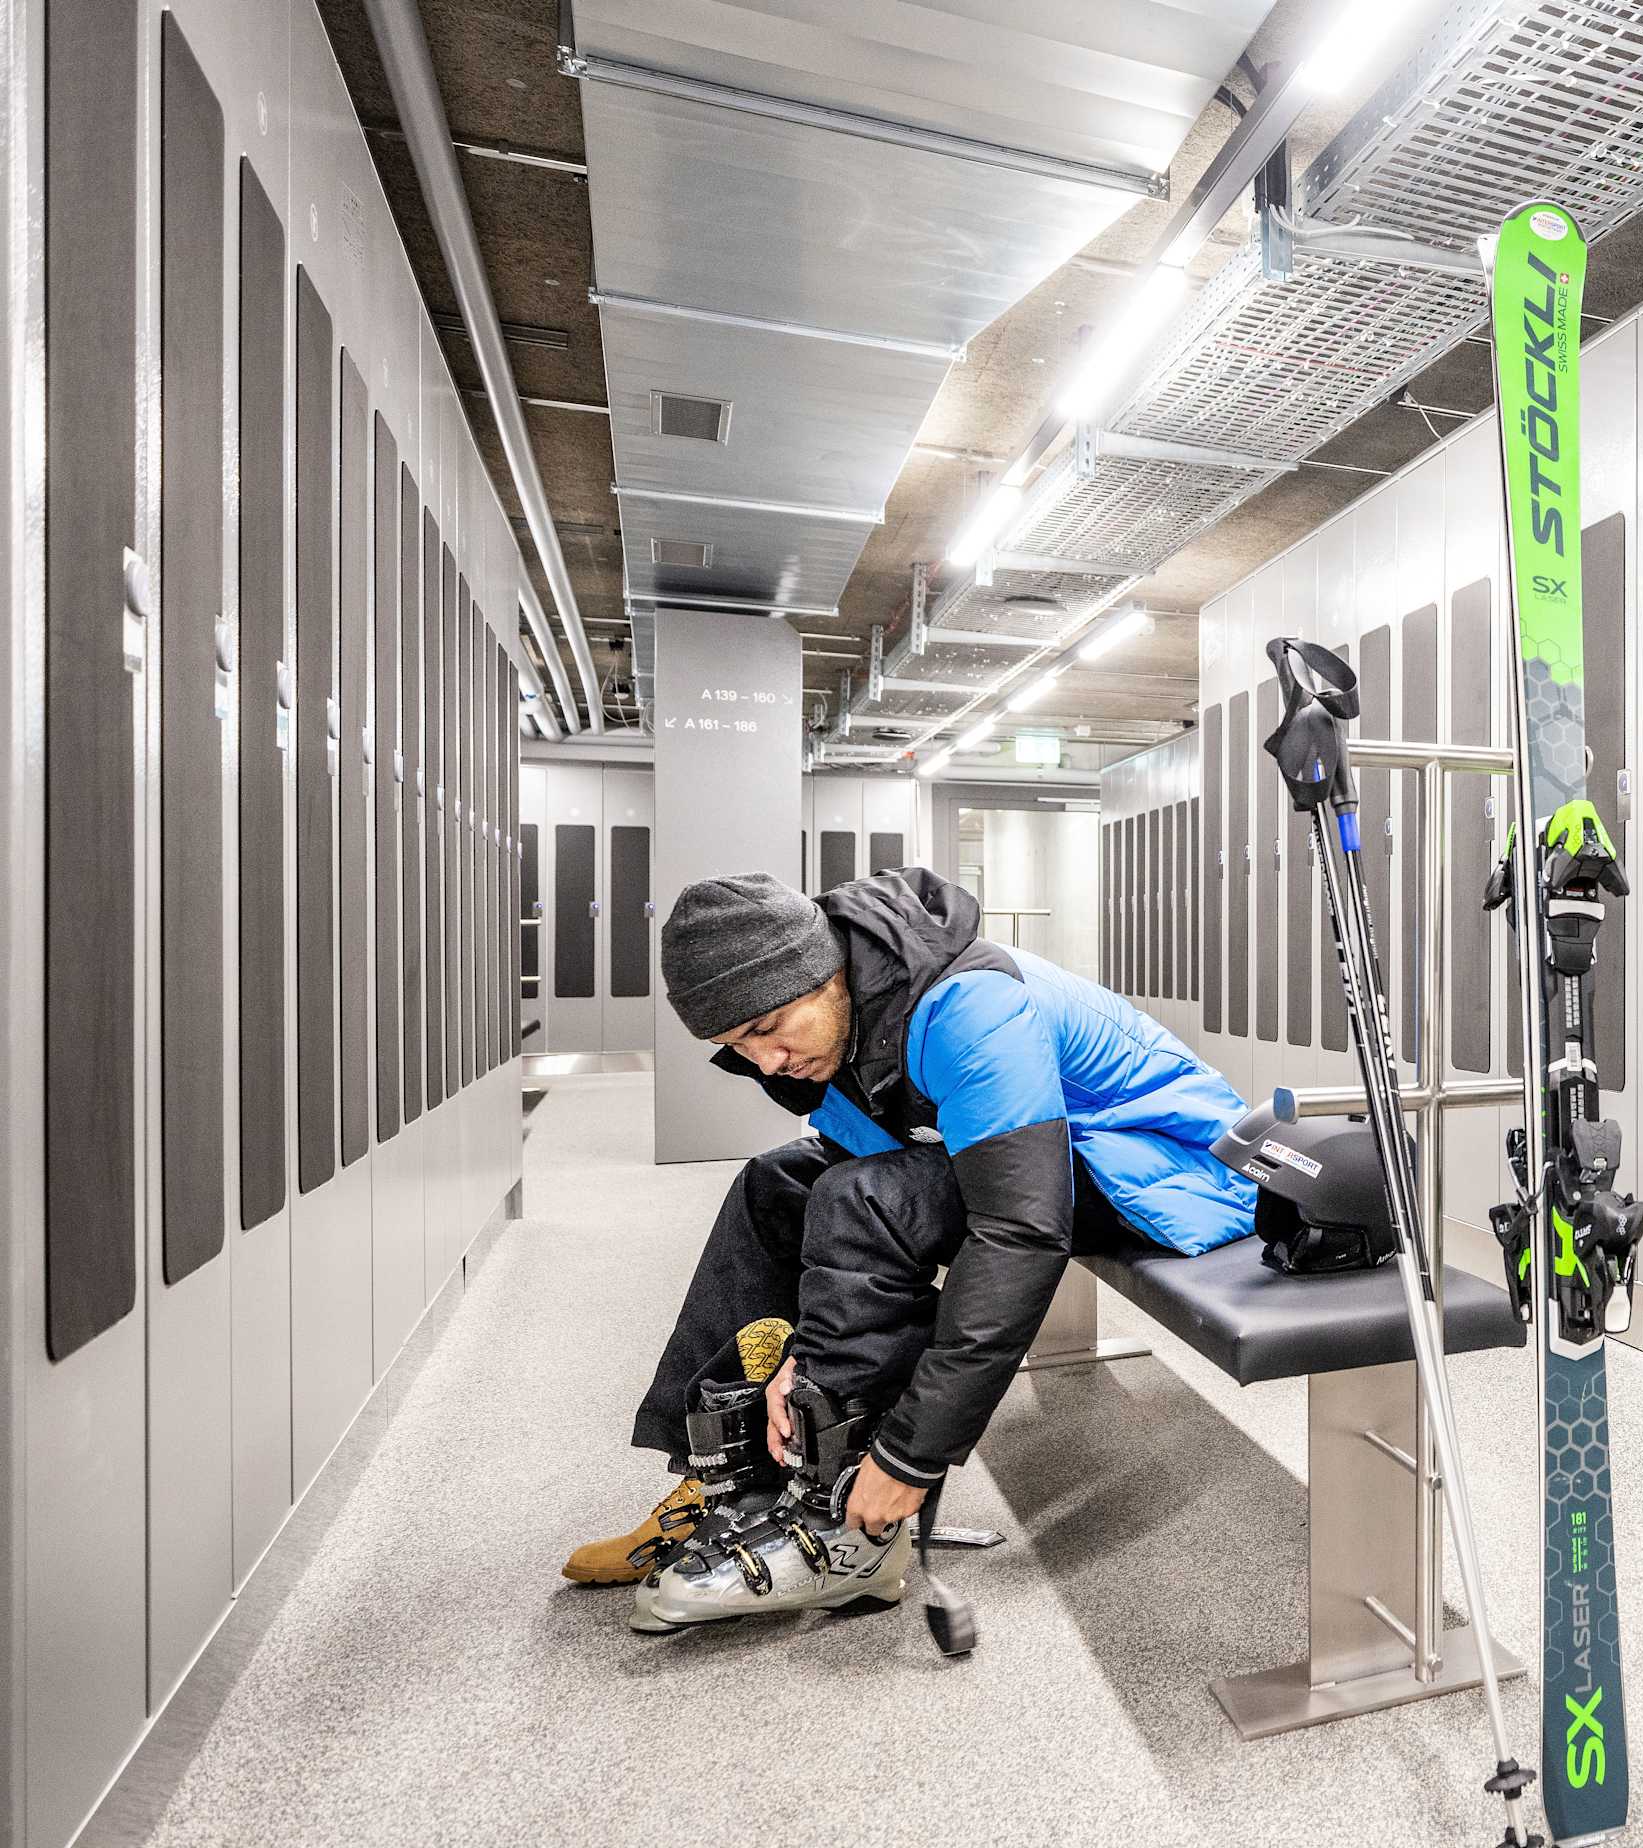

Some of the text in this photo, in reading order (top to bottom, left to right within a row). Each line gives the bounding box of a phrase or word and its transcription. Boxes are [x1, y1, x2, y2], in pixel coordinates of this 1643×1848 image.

[1557, 286, 1568, 373] SWISS MADE
[1521, 251, 1564, 557] STÖCKLI
[1532, 576, 1568, 597] SX
[701, 688, 712, 701] A
[714, 689, 737, 702] 139
[684, 718, 696, 729] A
[698, 718, 719, 731] 161
[733, 719, 757, 733] 186
[1570, 1511, 1587, 1526] 181
[1572, 1582, 1592, 1693] LASER
[1565, 1686, 1606, 1789] SX
